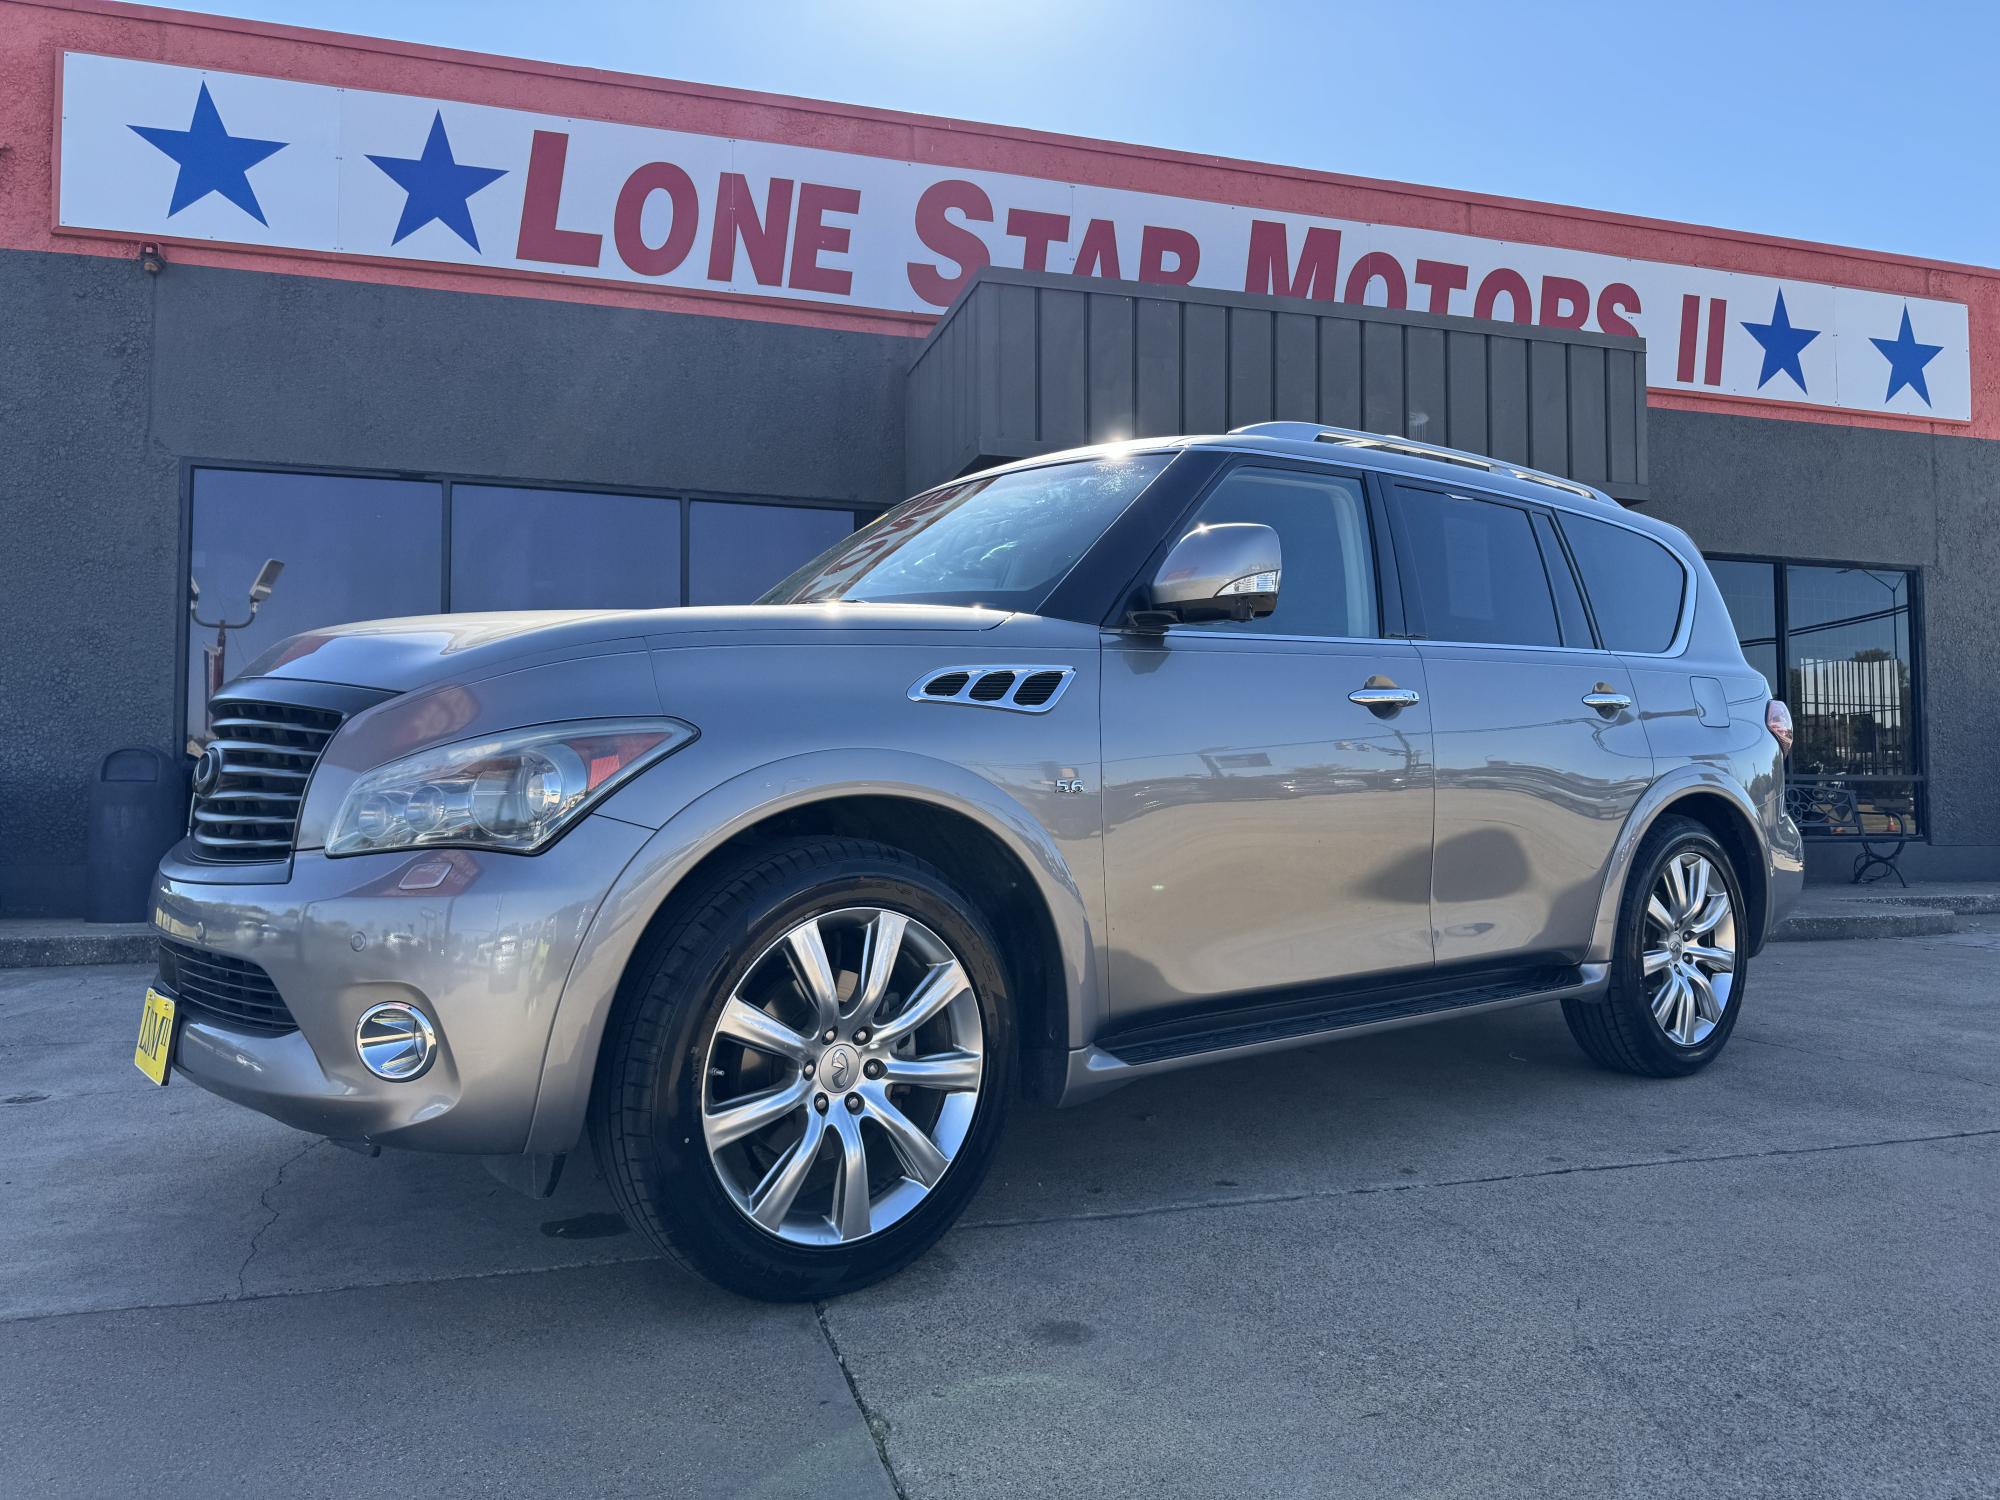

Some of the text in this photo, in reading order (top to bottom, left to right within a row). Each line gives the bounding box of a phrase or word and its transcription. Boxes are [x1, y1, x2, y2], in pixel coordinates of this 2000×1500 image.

[516, 129, 861, 296] LONE
[907, 179, 1201, 307] STAR
[1677, 294, 1727, 386] II
